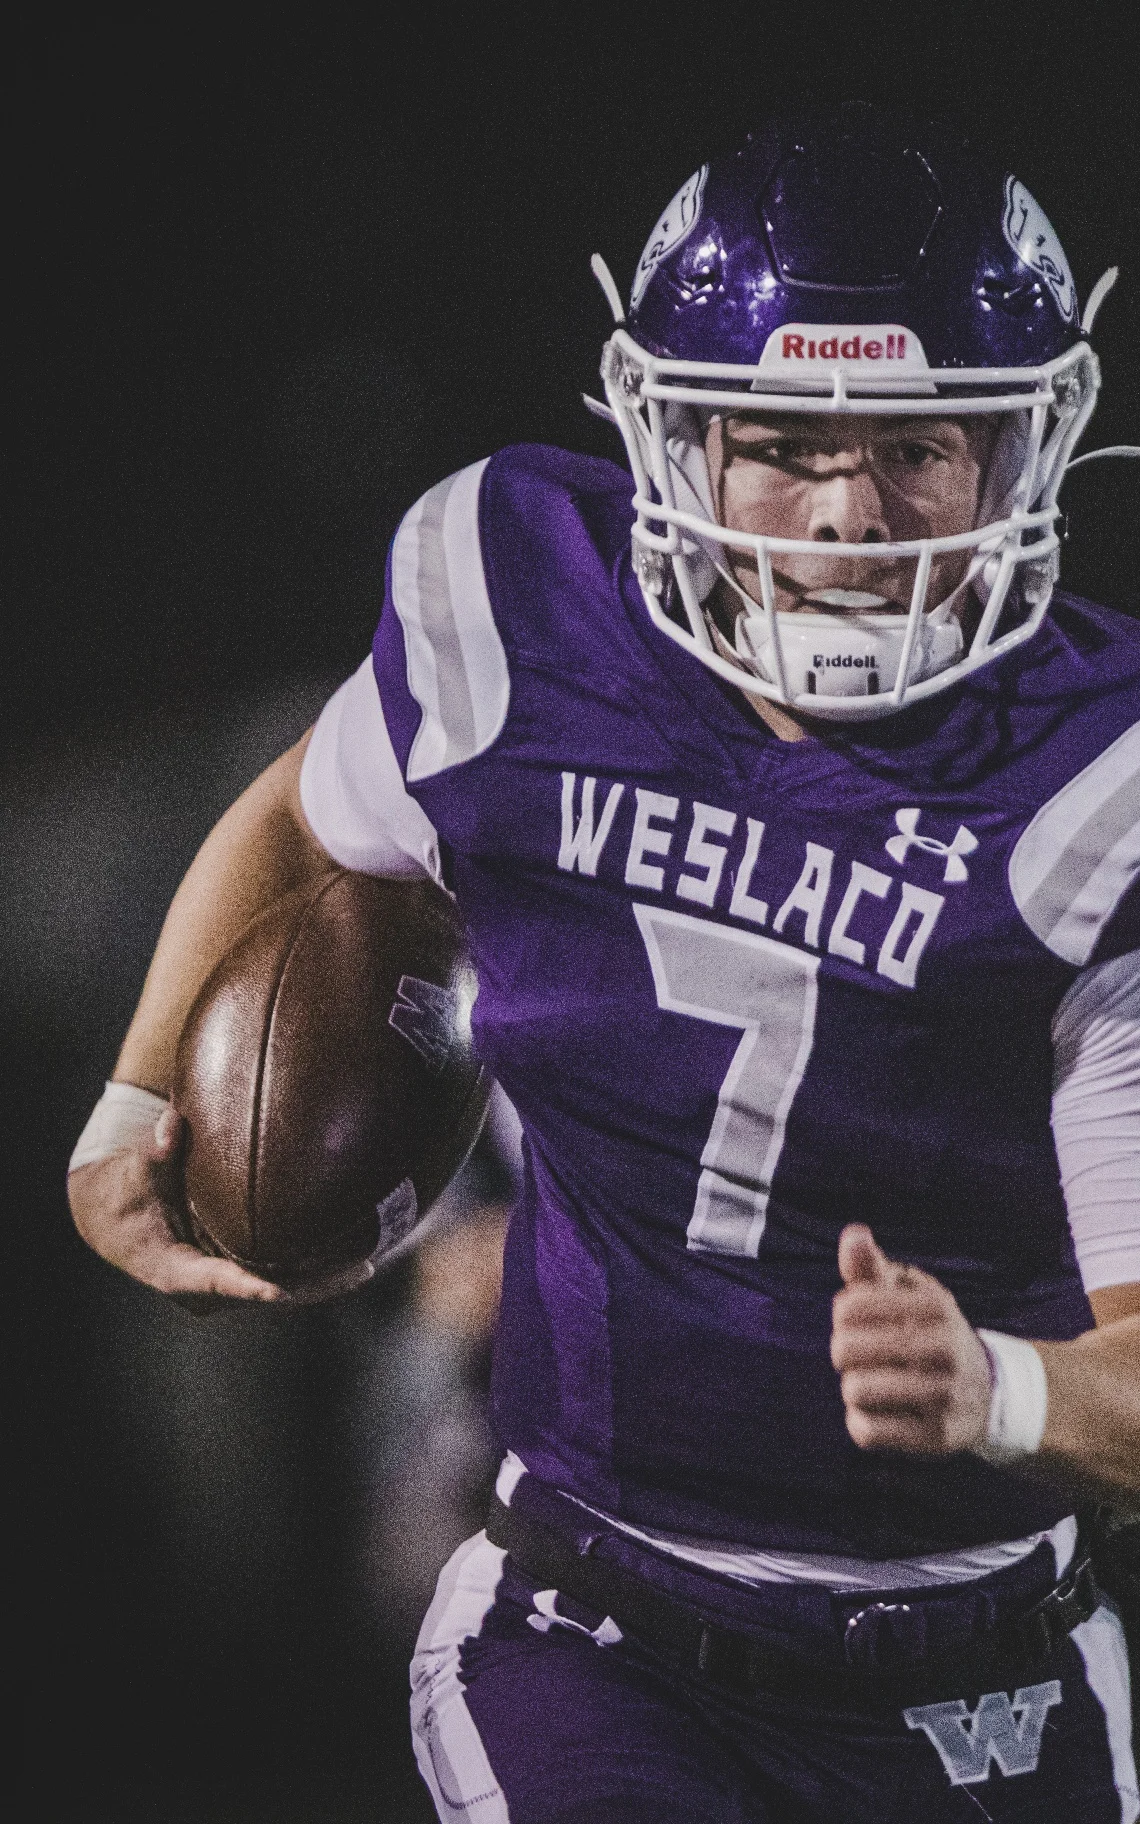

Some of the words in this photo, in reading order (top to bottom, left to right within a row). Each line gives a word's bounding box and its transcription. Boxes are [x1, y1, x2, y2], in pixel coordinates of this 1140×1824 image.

[781, 333, 907, 361] Riddell
[558, 771, 945, 989] WESLACO
[632, 902, 822, 1258] 7
[903, 1679, 1062, 1786] W
